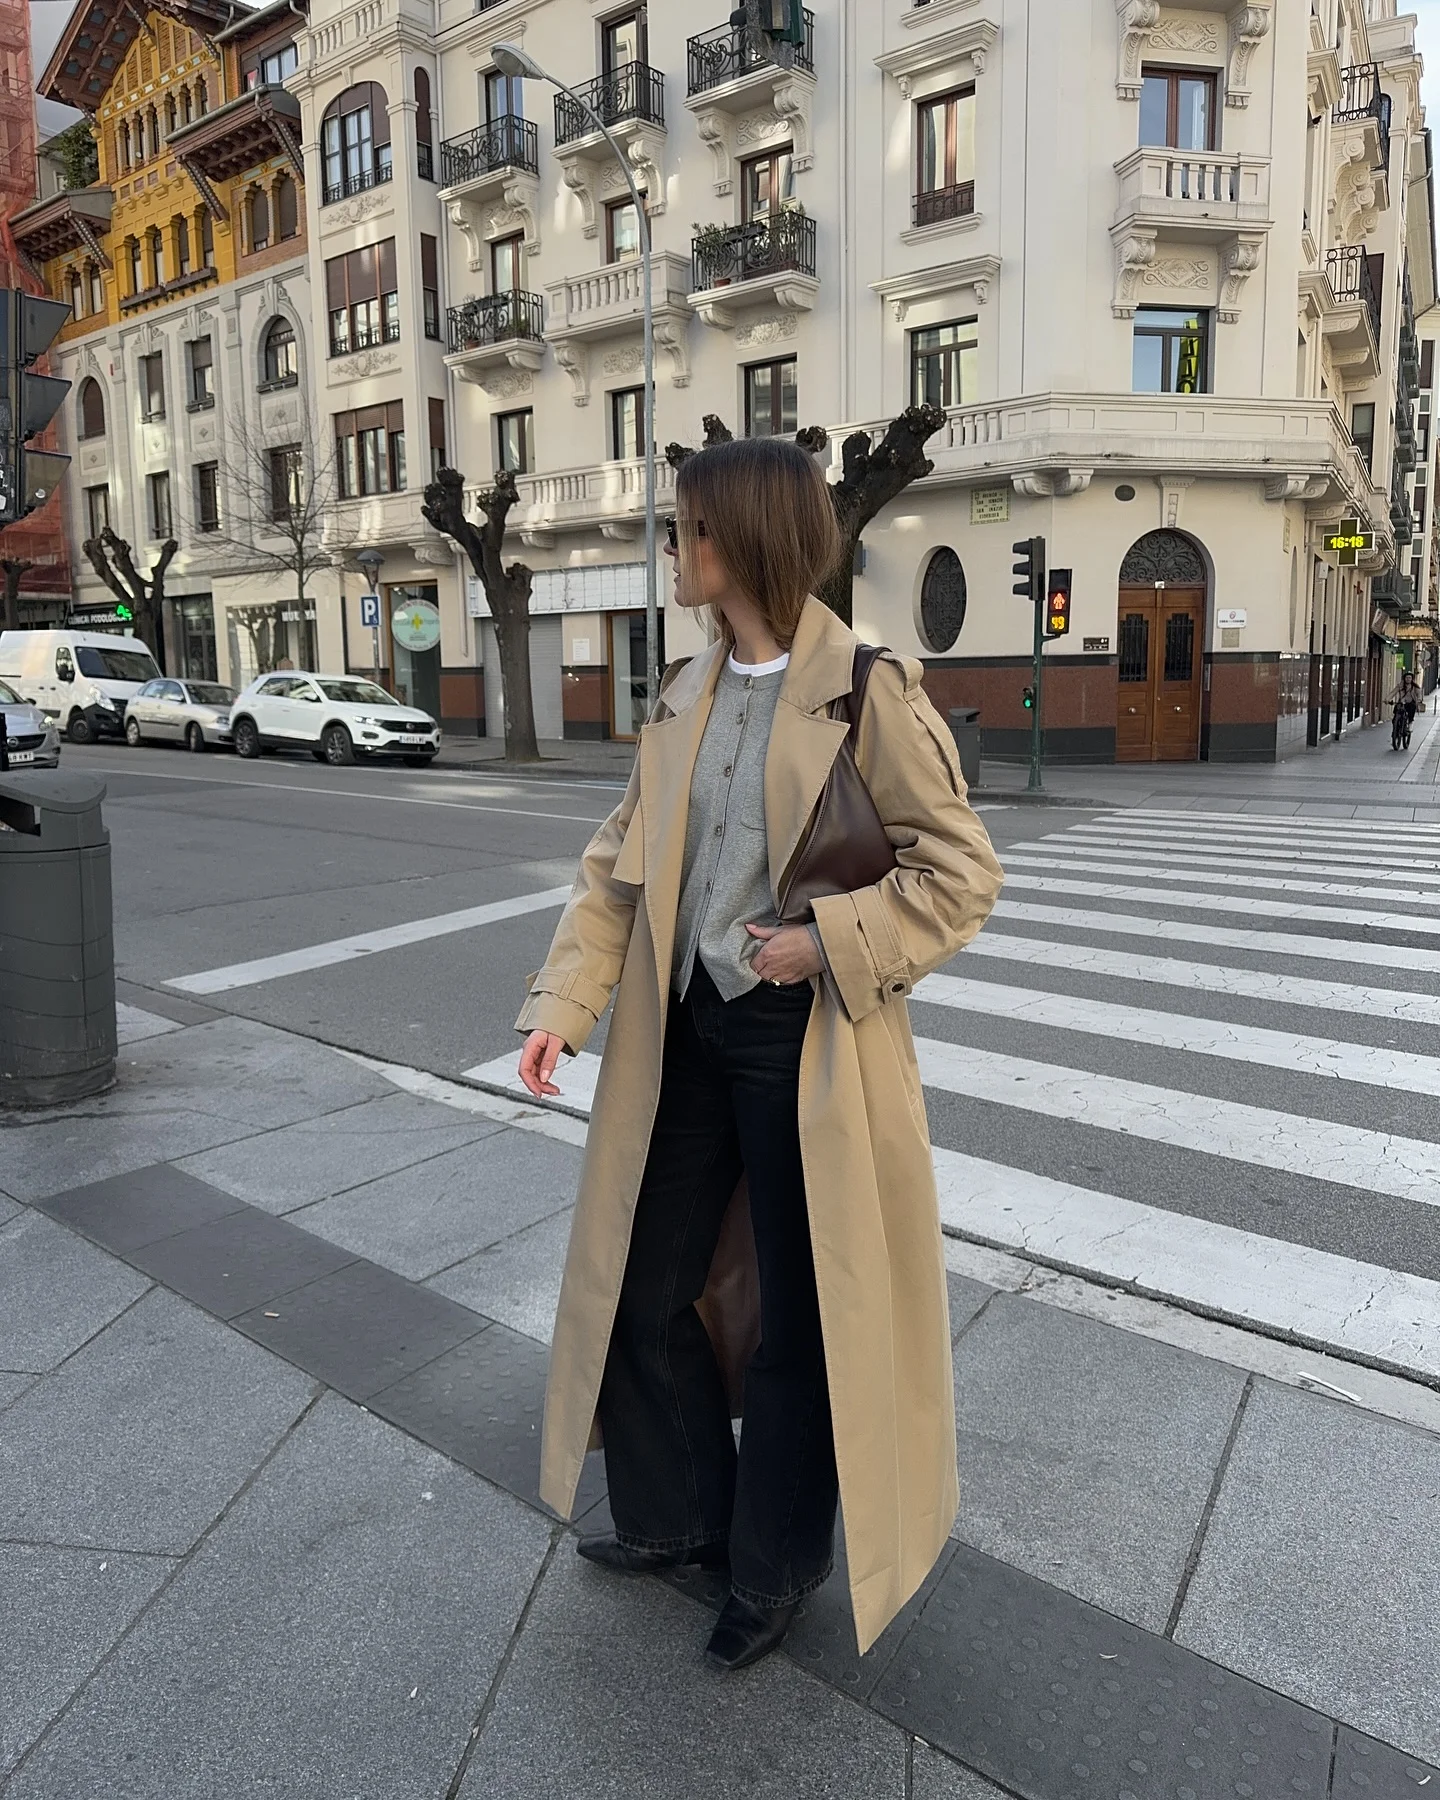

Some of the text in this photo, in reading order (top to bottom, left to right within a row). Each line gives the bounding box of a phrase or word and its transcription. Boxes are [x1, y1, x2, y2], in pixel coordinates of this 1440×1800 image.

[1330, 535, 1364, 549] 16:18
[281, 609, 316, 622] MULYA
[363, 599, 376, 624] P
